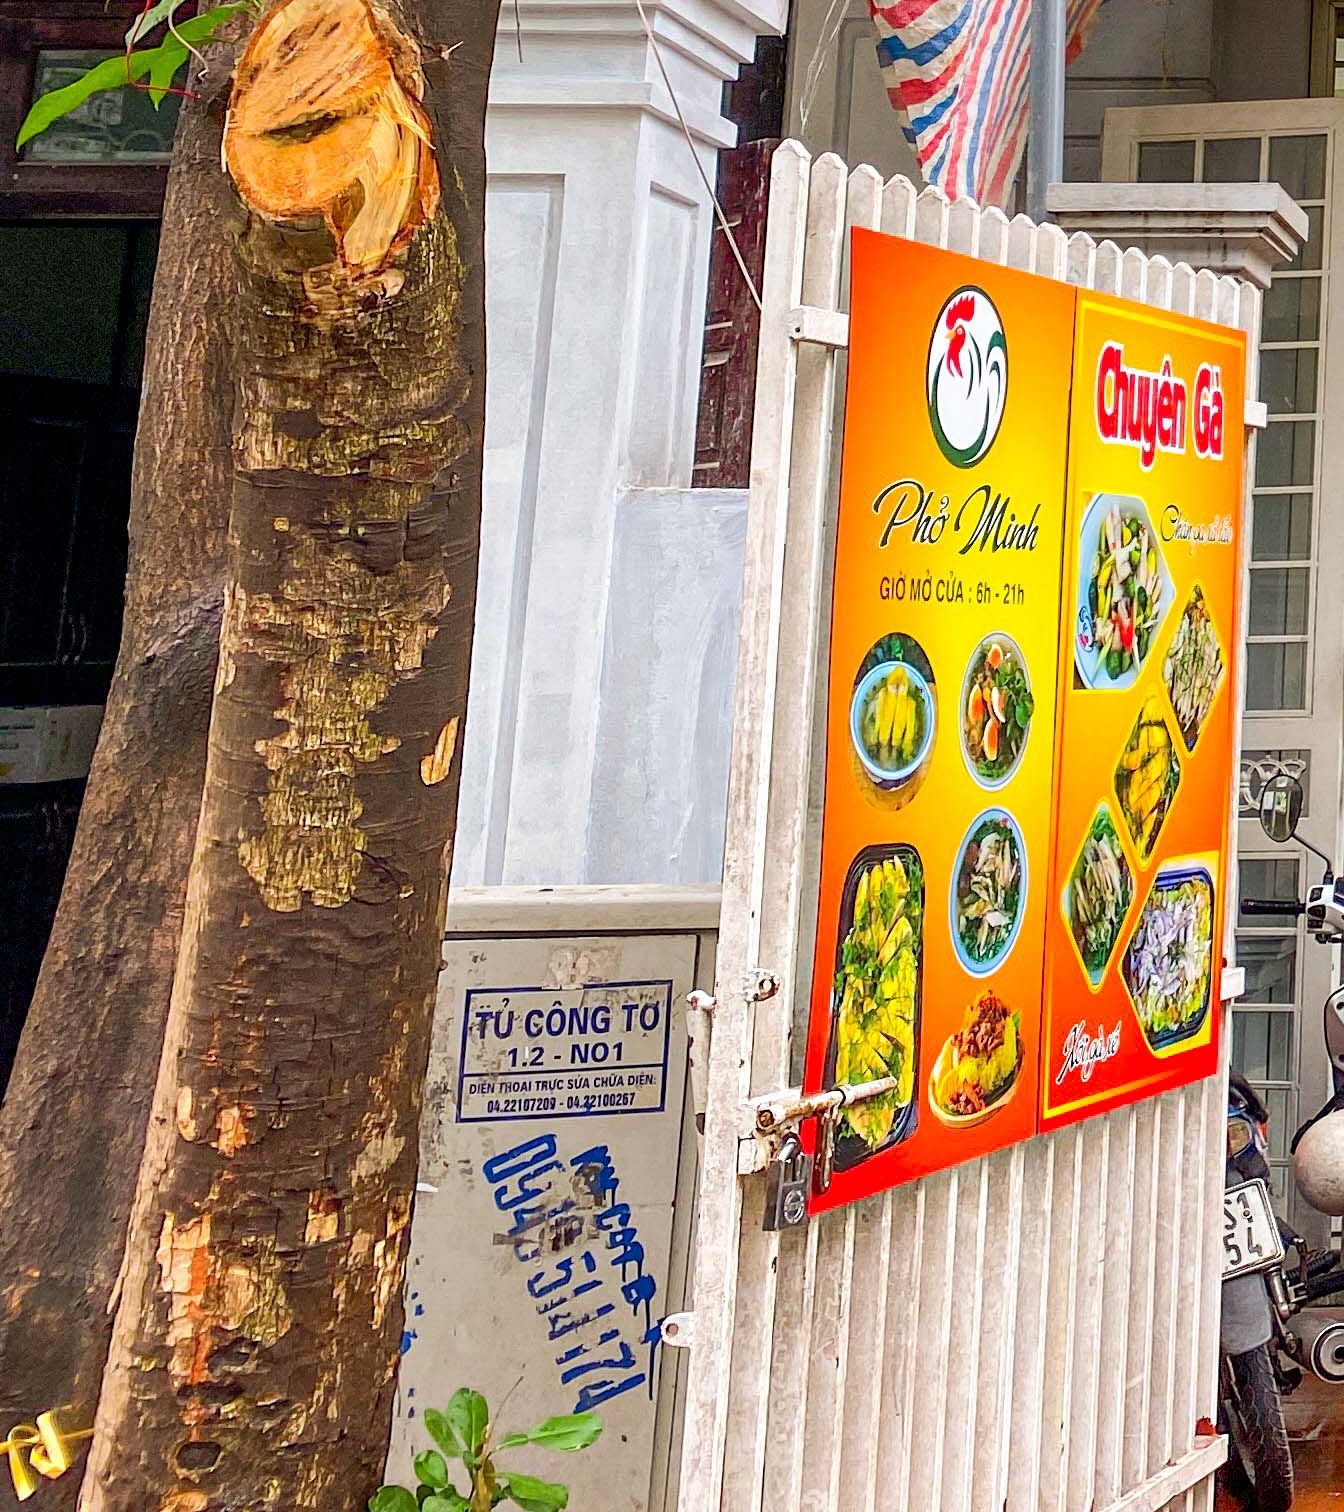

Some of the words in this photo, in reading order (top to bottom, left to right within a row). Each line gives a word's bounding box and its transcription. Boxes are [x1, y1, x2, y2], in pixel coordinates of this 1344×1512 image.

[1096, 340, 1187, 471] Chuyên
[1192, 362, 1225, 462] Gà
[872, 479, 950, 549] Phở
[954, 484, 1041, 555] Minh
[880, 571, 906, 600] GIỜ
[910, 569, 932, 602] MỞ
[936, 571, 963, 603] CỬA
[976, 582, 991, 604] 6h
[1003, 583, 1024, 605] 21h
[476, 997, 514, 1039] TỦ
[524, 1000, 611, 1038] CÔNG
